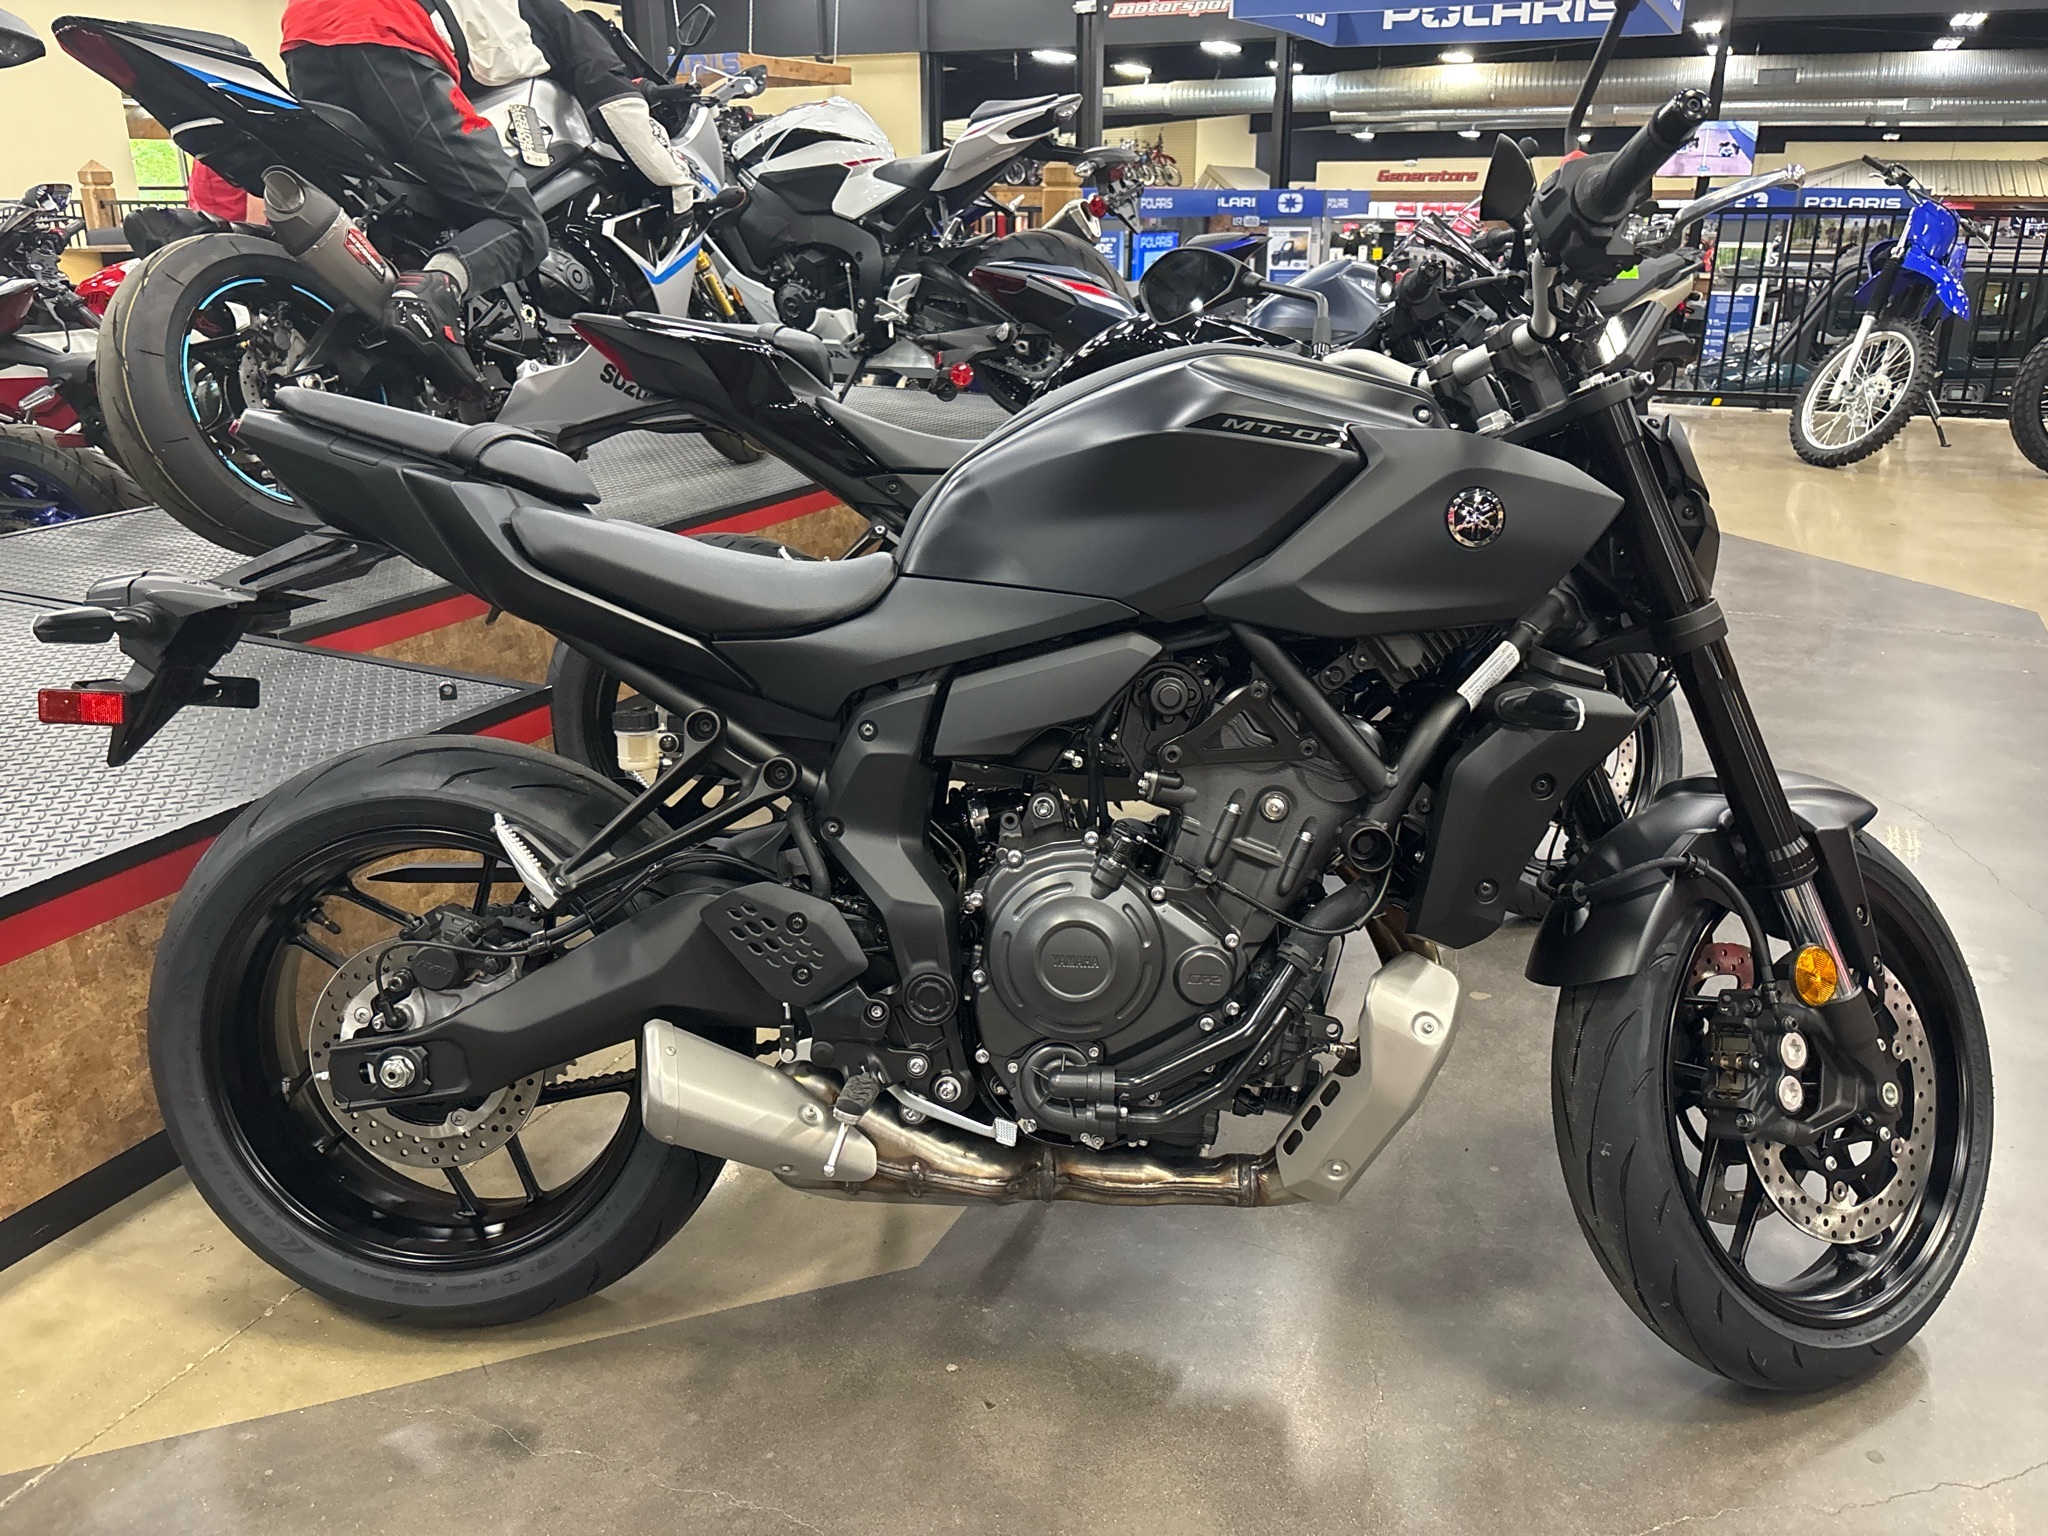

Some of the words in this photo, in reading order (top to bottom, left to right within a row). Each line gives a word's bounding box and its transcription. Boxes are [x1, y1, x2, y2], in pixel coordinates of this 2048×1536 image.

[1377, 170, 1478, 182] Generators
[1140, 198, 1173, 209] POLARIS
[1804, 196, 1901, 209] POLARIS
[1140, 237, 1173, 248] POLARIS
[600, 363, 653, 400] SUZU
[1052, 953, 1100, 968] YAMAHA
